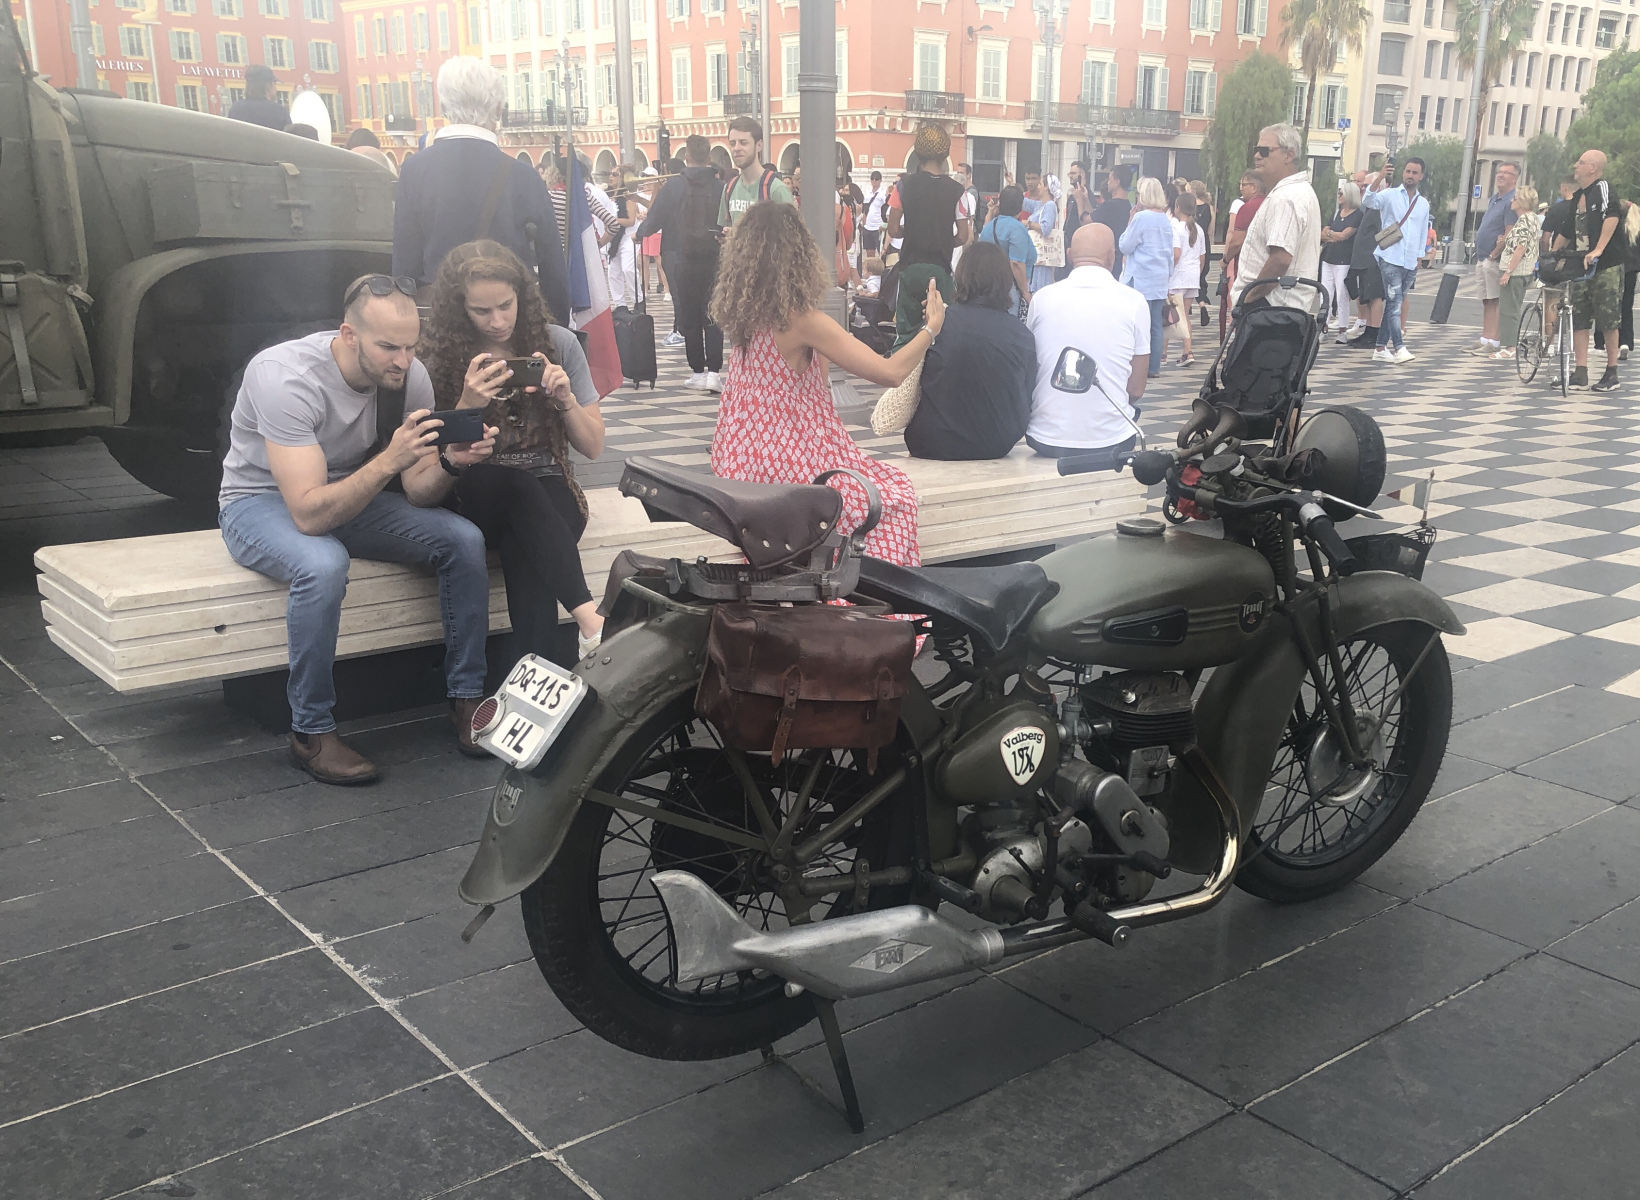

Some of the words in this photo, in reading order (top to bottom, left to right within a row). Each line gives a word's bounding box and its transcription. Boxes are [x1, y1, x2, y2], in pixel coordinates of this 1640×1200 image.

[94, 59, 144, 71] ALERIES
[182, 65, 244, 79] LAFAYETTE
[508, 664, 570, 710] DQ-115
[501, 717, 534, 754] HL
[1003, 732, 1044, 749] Valberg
